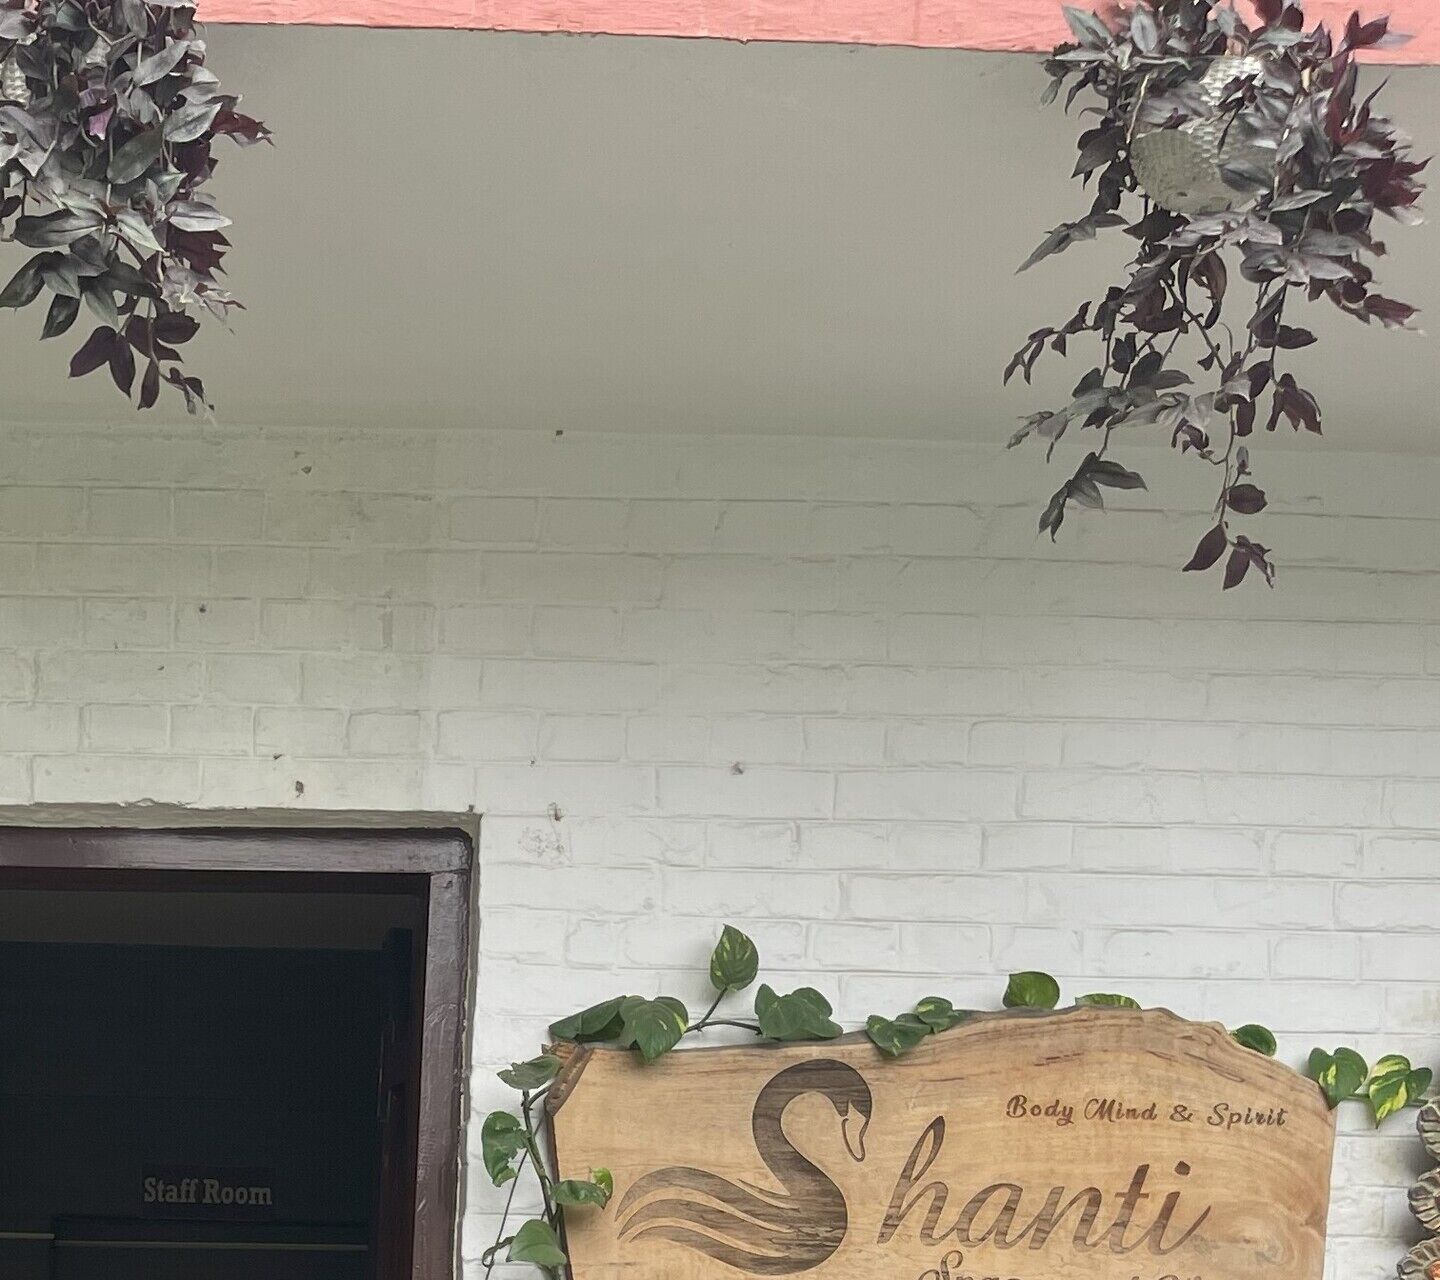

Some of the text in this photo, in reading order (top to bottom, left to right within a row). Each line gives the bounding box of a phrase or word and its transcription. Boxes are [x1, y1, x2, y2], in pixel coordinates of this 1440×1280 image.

[1006, 1094, 1289, 1130] Body Mind & Spirit
[144, 1177, 273, 1205] Staff Room
